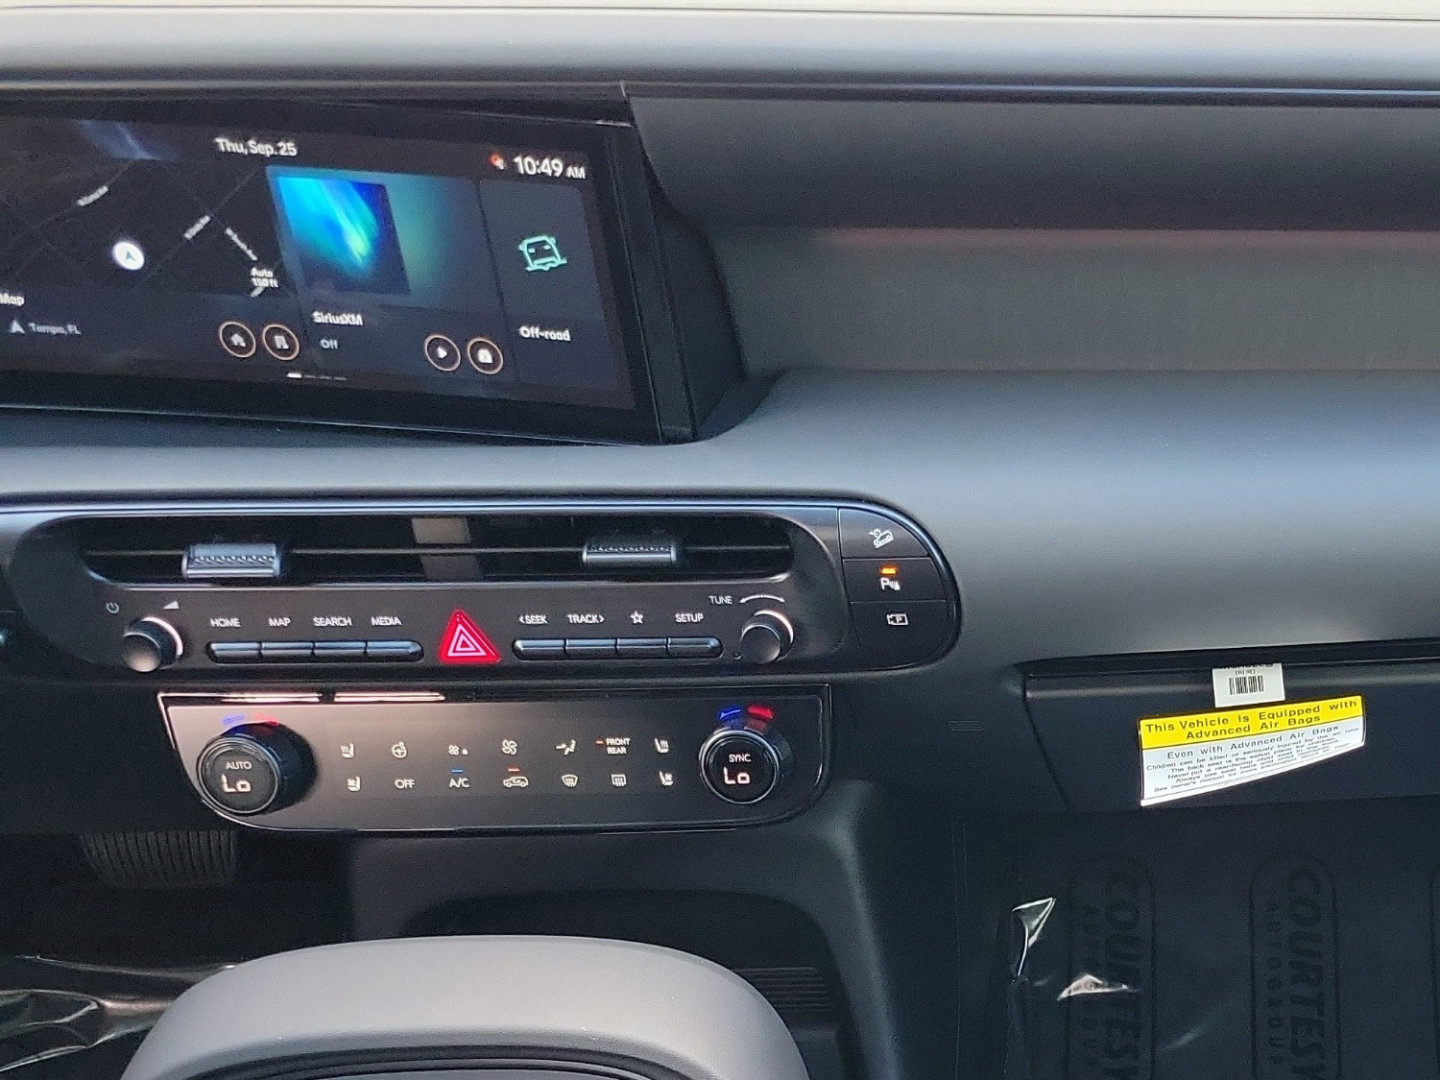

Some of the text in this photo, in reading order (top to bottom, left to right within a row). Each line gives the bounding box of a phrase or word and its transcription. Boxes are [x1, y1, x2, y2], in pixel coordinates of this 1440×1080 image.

[215, 137, 297, 157] Thu, Sep. 25
[513, 155, 586, 179] 10:49 AM
[312, 311, 364, 326] SiriusXM
[519, 326, 571, 342] Off-road
[320, 338, 339, 350] Off
[709, 595, 733, 605] TUNE
[210, 617, 241, 627] HOME
[268, 617, 291, 627] MAP
[313, 617, 352, 627] SEARCH
[371, 616, 402, 626] MEDIA
[675, 613, 704, 623] SETUP
[1145, 700, 1357, 733] This Vehicle is Equipped with
[1186, 715, 1321, 740] Advanced Air Bags
[606, 737, 631, 746] FRONT
[1167, 750, 1193, 760] Even
[1199, 746, 1223, 755] with
[1230, 736, 1283, 750] Advanced
[1289, 731, 1306, 740] Air
[1312, 725, 1339, 735] Bags
[607, 747, 627, 755] REAR
[729, 753, 752, 763] SYNC
[225, 760, 252, 770] AUTO
[394, 779, 415, 789] OFF
[449, 777, 471, 788] A/C
